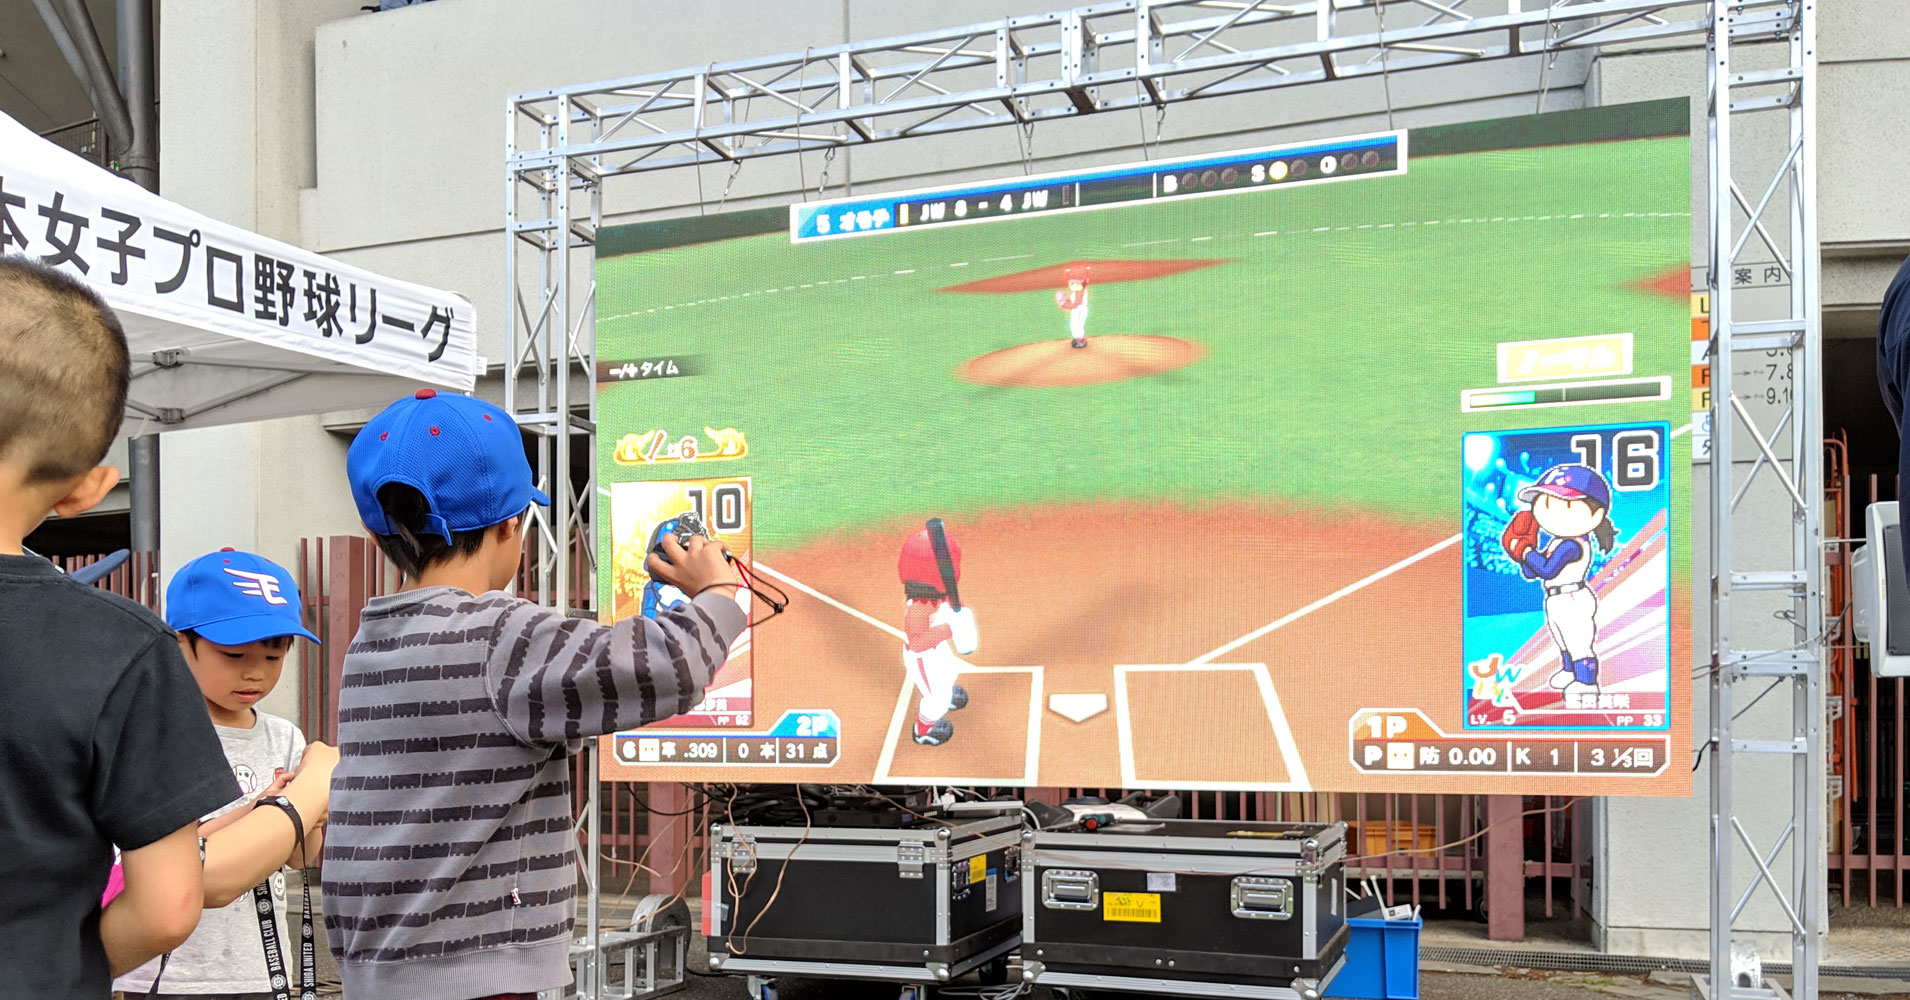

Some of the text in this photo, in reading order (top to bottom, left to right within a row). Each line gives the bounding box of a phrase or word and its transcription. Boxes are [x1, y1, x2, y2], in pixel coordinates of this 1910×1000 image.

[1163, 174, 1178, 193] B
[1251, 164, 1266, 183] S
[816, 214, 830, 234] 5
[920, 201, 946, 221] JW
[1000, 194, 1012, 213] 4
[1021, 189, 1049, 210] JW
[1573, 432, 1657, 489] 16
[687, 485, 744, 532] 10
[796, 715, 827, 736] 2P
[1367, 715, 1408, 738] 1P
[1502, 709, 1517, 725] 5
[622, 741, 636, 759] 6
[683, 742, 717, 759] .309
[738, 742, 749, 759] 0
[786, 743, 804, 759] 31
[812, 741, 828, 759] 点
[1364, 745, 1383, 765] P
[1448, 747, 1496, 766] 0.00
[1515, 747, 1531, 766] K
[1549, 748, 1559, 766] 1
[261, 919, 281, 972] BASEBALL CLUB
[303, 942, 315, 988] SHIGA UNITED
